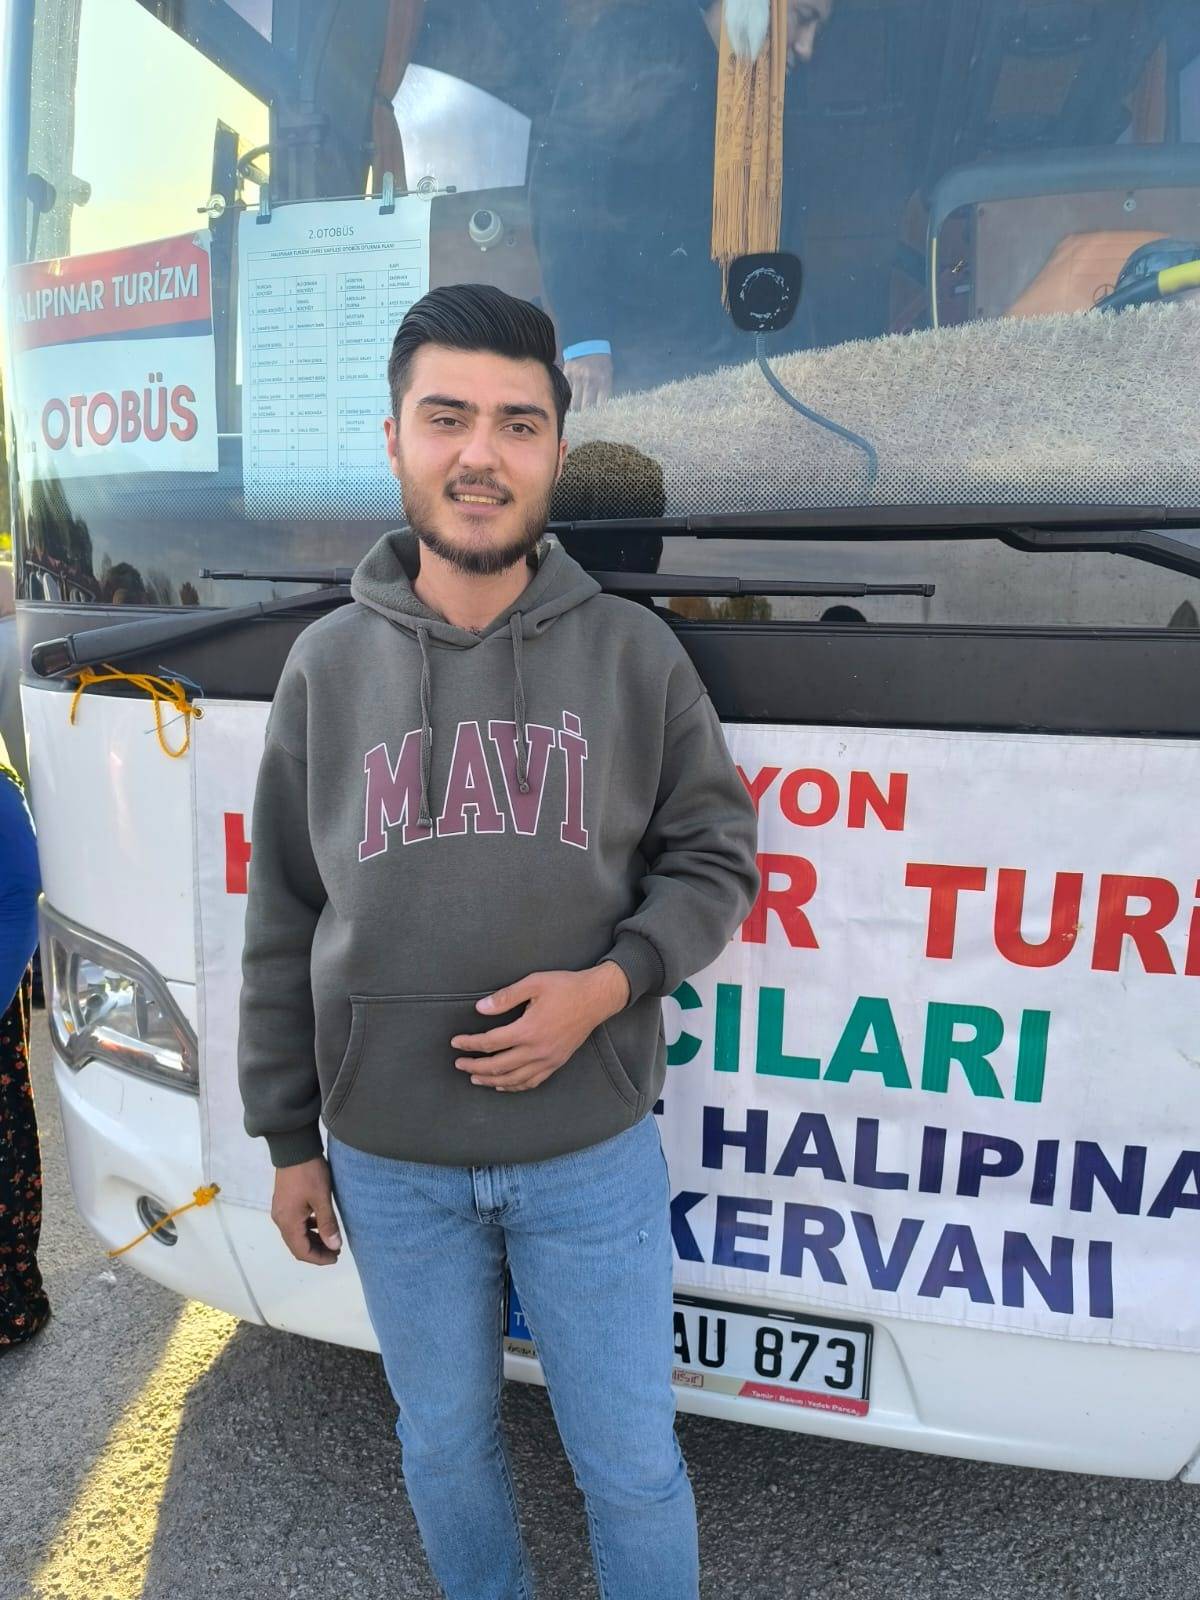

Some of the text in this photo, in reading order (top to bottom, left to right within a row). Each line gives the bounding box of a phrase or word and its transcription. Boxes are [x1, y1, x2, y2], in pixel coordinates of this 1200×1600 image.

[15, 261, 199, 322] ALIPINAR TURİZM
[41, 371, 199, 451] OTOBÜS
[358, 710, 589, 862] MAVİ
[665, 980, 1051, 1103] CILARI
[702, 1105, 1200, 1219] HALIPINA
[670, 1190, 1114, 1320] KERVANI
[751, 1389, 774, 1401] Tamir
[807, 1400, 831, 1410] Yedek
[754, 1325, 856, 1391] 873
